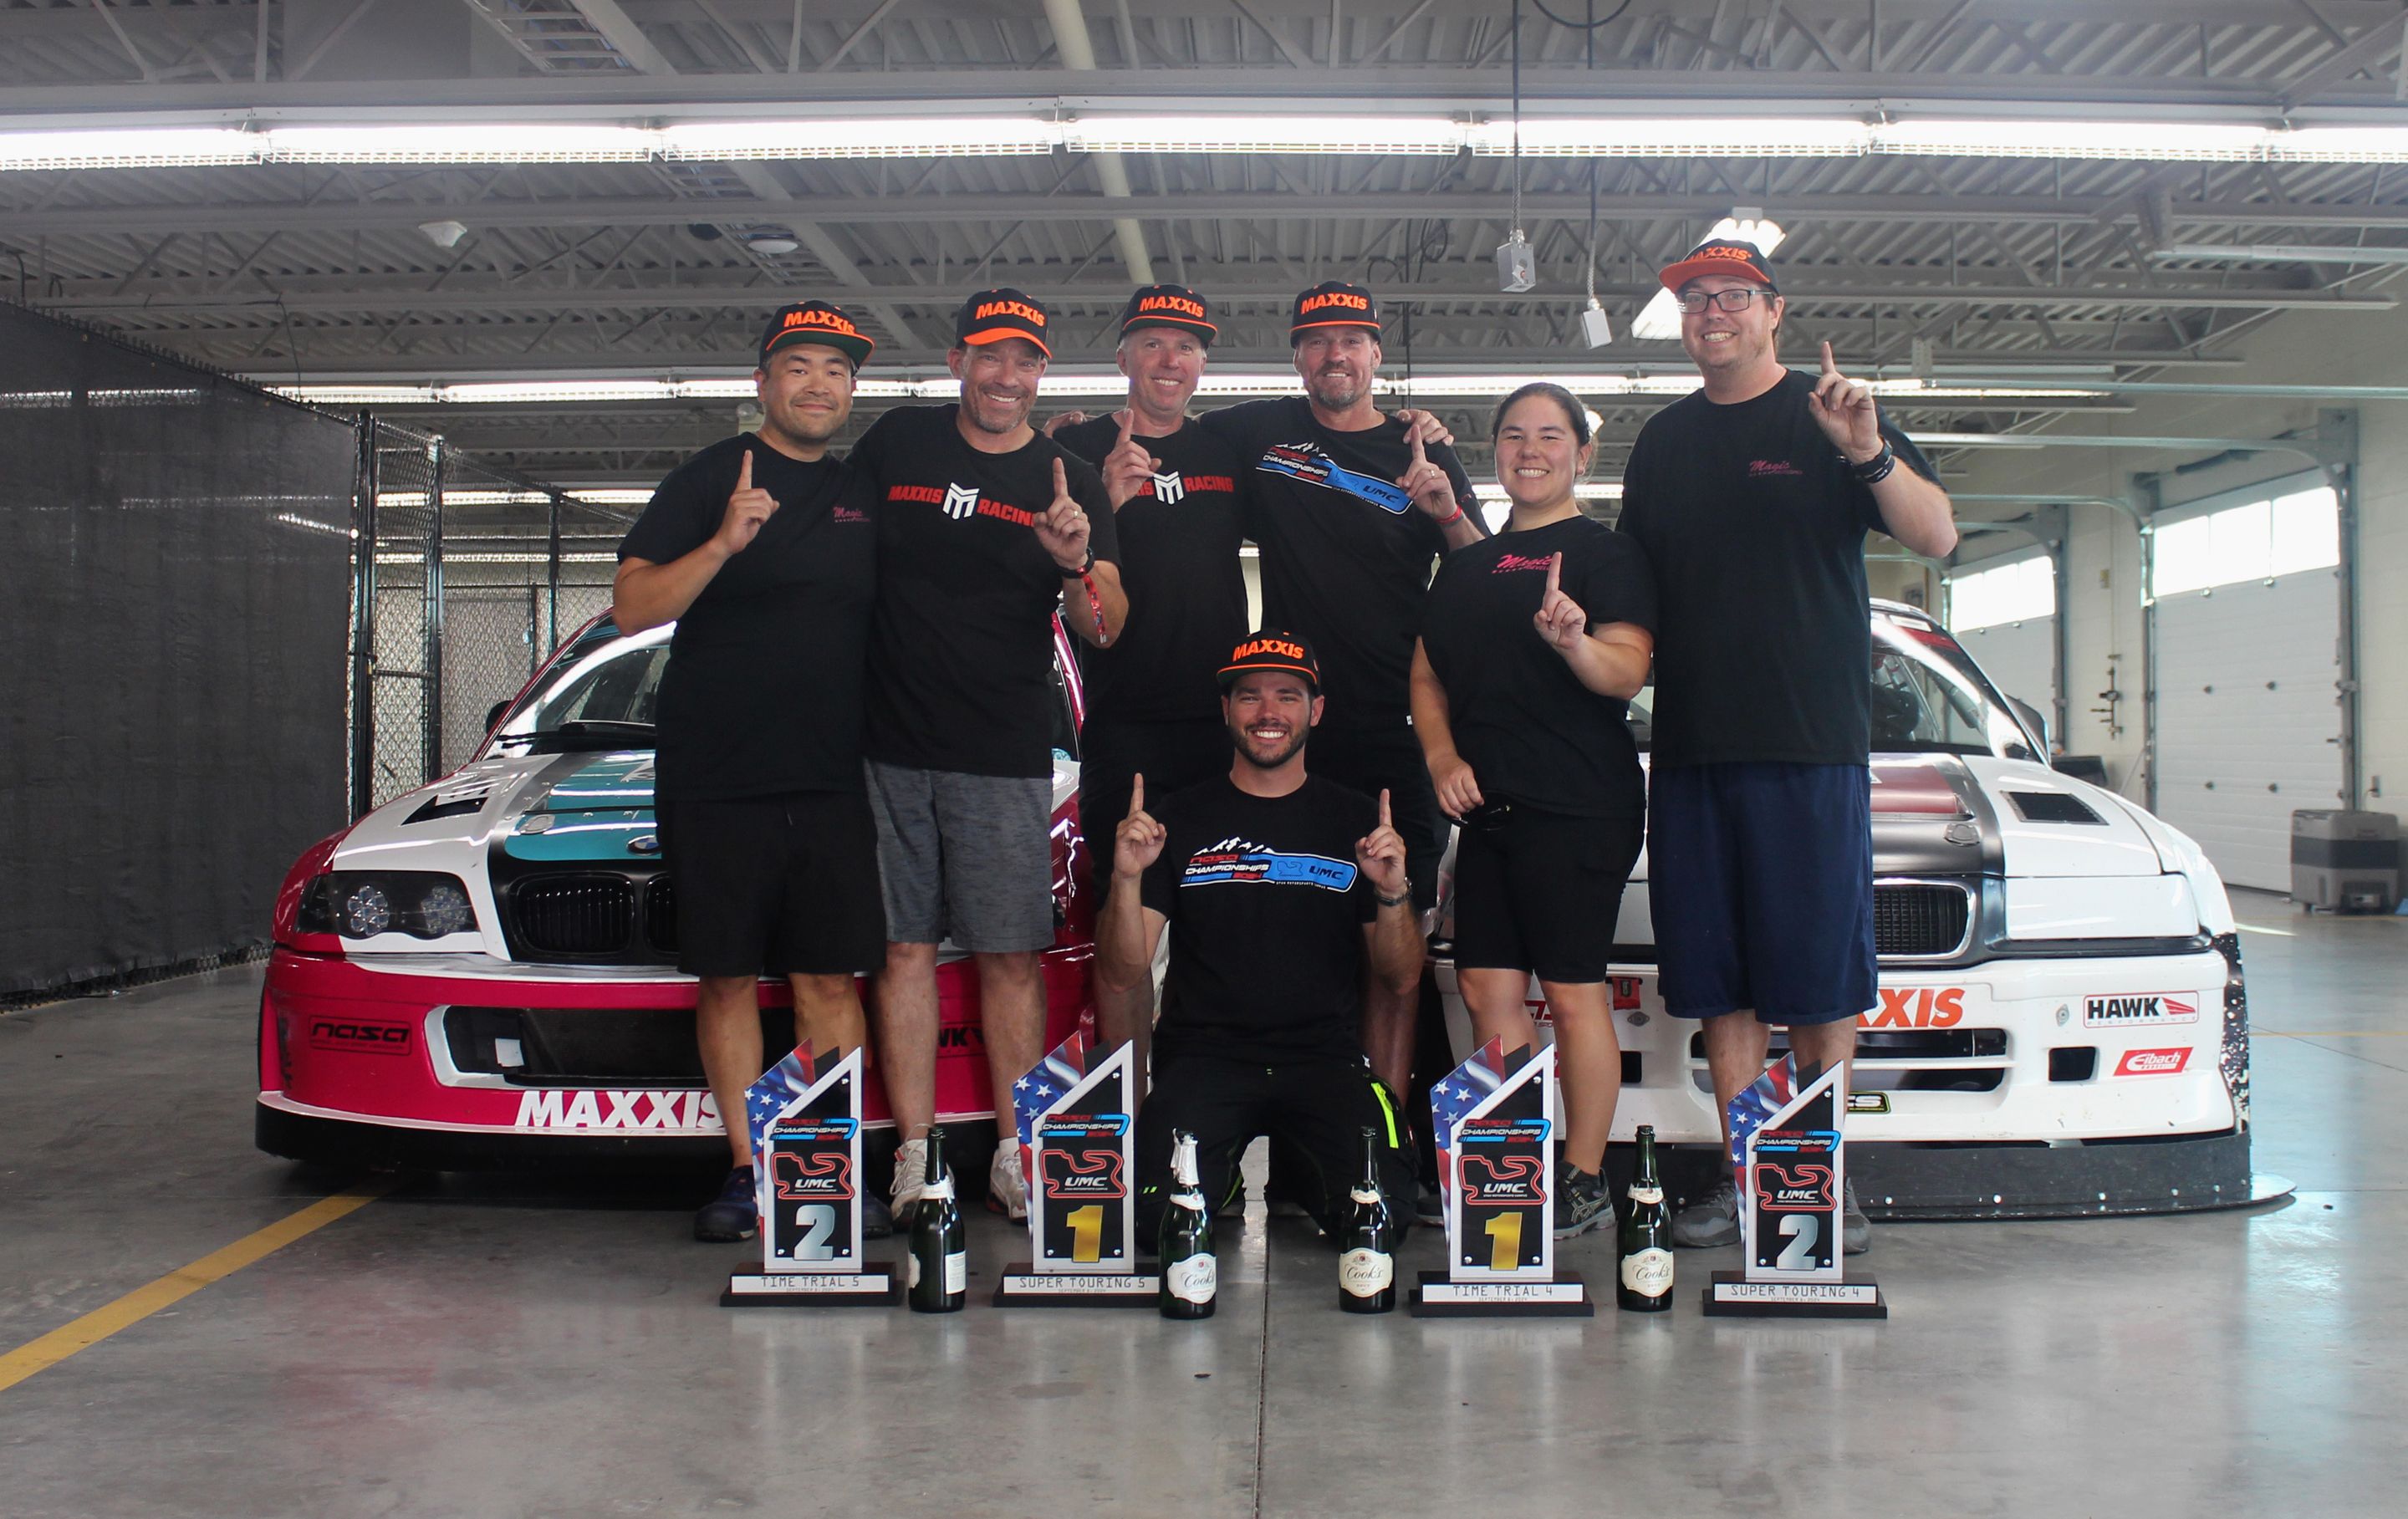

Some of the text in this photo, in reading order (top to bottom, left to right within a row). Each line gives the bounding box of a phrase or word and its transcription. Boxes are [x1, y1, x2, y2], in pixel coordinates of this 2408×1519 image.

[975, 300, 1045, 328] MAXXIS
[1139, 295, 1204, 319] MAXXIS
[1300, 293, 1368, 315] MAXXIS
[783, 310, 855, 335] MAXXIS
[1263, 454, 1329, 477] CHAMPIONSHIPS
[1183, 476, 1234, 492] RACING
[1363, 484, 1400, 503] UMC
[887, 485, 1035, 528] MAXXIS RACIN
[1232, 640, 1303, 662] MAXXIS
[1185, 864, 1270, 875] CHAMPIONSHIPS
[1309, 865, 1344, 879] UMC
[2088, 997, 2160, 1019] HAWK
[2125, 1051, 2183, 1072] Eibach
[514, 1090, 724, 1129] MAXXIS
[1461, 1128, 1542, 1136] CHAMPIONSHIPS
[794, 1178, 837, 1189] UMC
[1064, 1176, 1108, 1187] UMC
[1482, 1182, 1528, 1193] UMC
[1776, 1190, 1819, 1200] UMC
[793, 1205, 836, 1261] 2
[1066, 1205, 1104, 1262] 1
[1484, 1212, 1523, 1271] 1
[1775, 1215, 1819, 1271] 2
[761, 1276, 860, 1287] TIME TRIAL 5
[1344, 1263, 1385, 1280] Cook's
[1632, 1262, 1671, 1282] Cook's
[1019, 1277, 1145, 1288] SUPER TOURING 5
[1452, 1285, 1553, 1297] TIME TRIAL 4
[1731, 1285, 1860, 1298] SUPER TOURING 4
